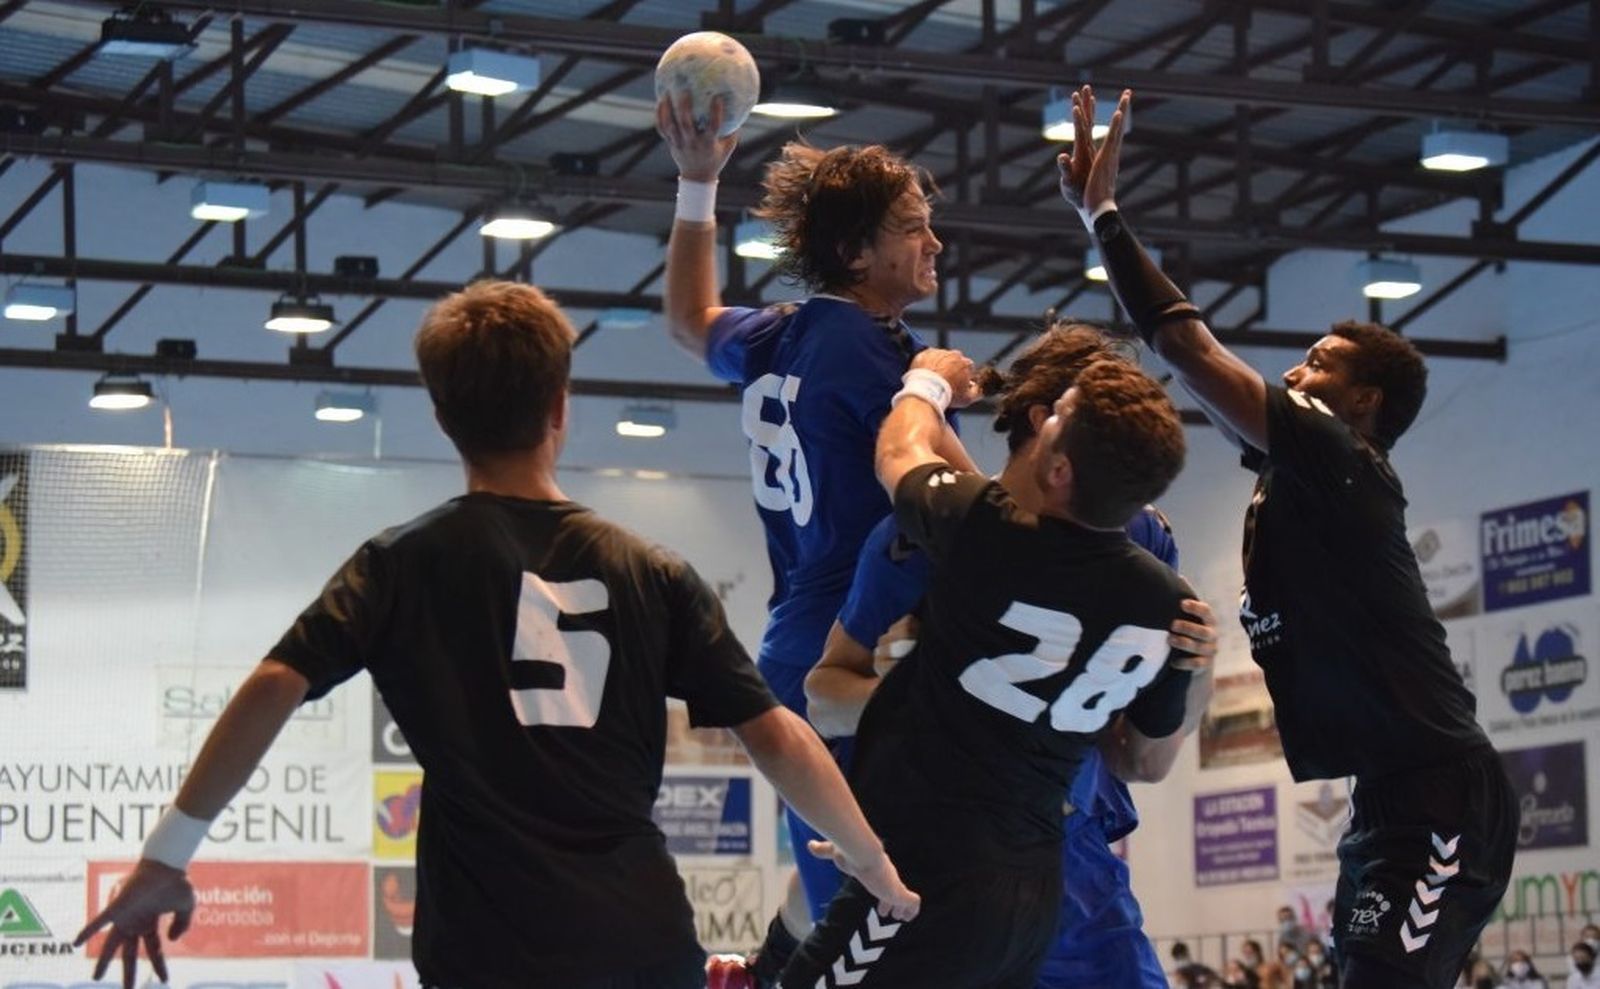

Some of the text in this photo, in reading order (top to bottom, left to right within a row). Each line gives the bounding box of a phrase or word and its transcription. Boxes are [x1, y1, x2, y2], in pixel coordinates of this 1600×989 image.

[509, 569, 611, 728] 5
[959, 601, 1170, 733] 28
[0, 765, 327, 793] AYUNTAMIEO DE
[206, 803, 344, 843] GENIL
[195, 884, 273, 905] utación
[199, 907, 274, 926] Córdoba
